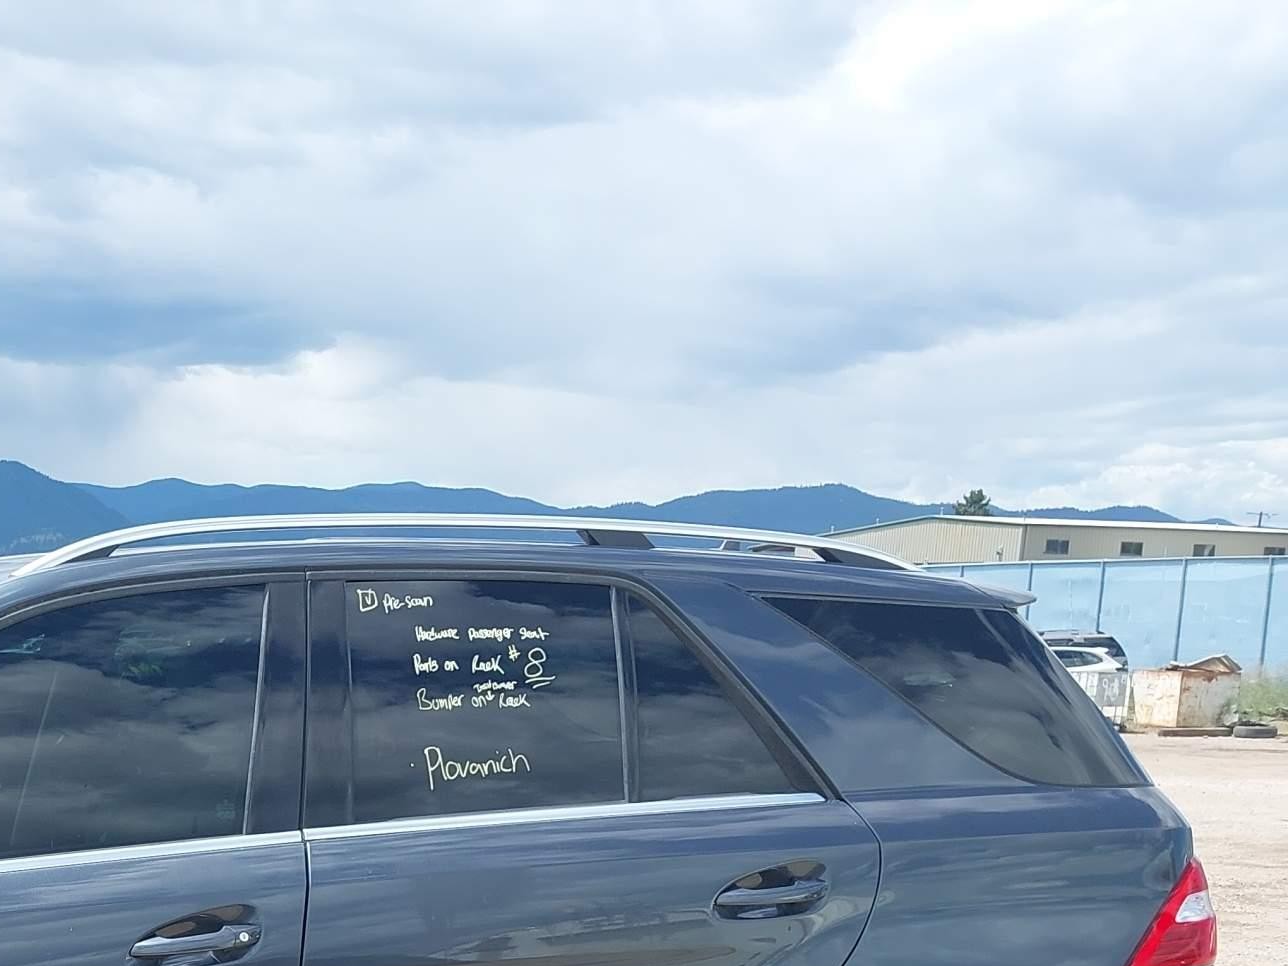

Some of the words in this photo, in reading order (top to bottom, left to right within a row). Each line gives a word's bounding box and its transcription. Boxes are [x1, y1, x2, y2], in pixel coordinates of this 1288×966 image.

[444, 660, 460, 671] on
[524, 647, 547, 678] 8
[471, 695, 487, 708] on
[424, 746, 531, 791] Plovanich
